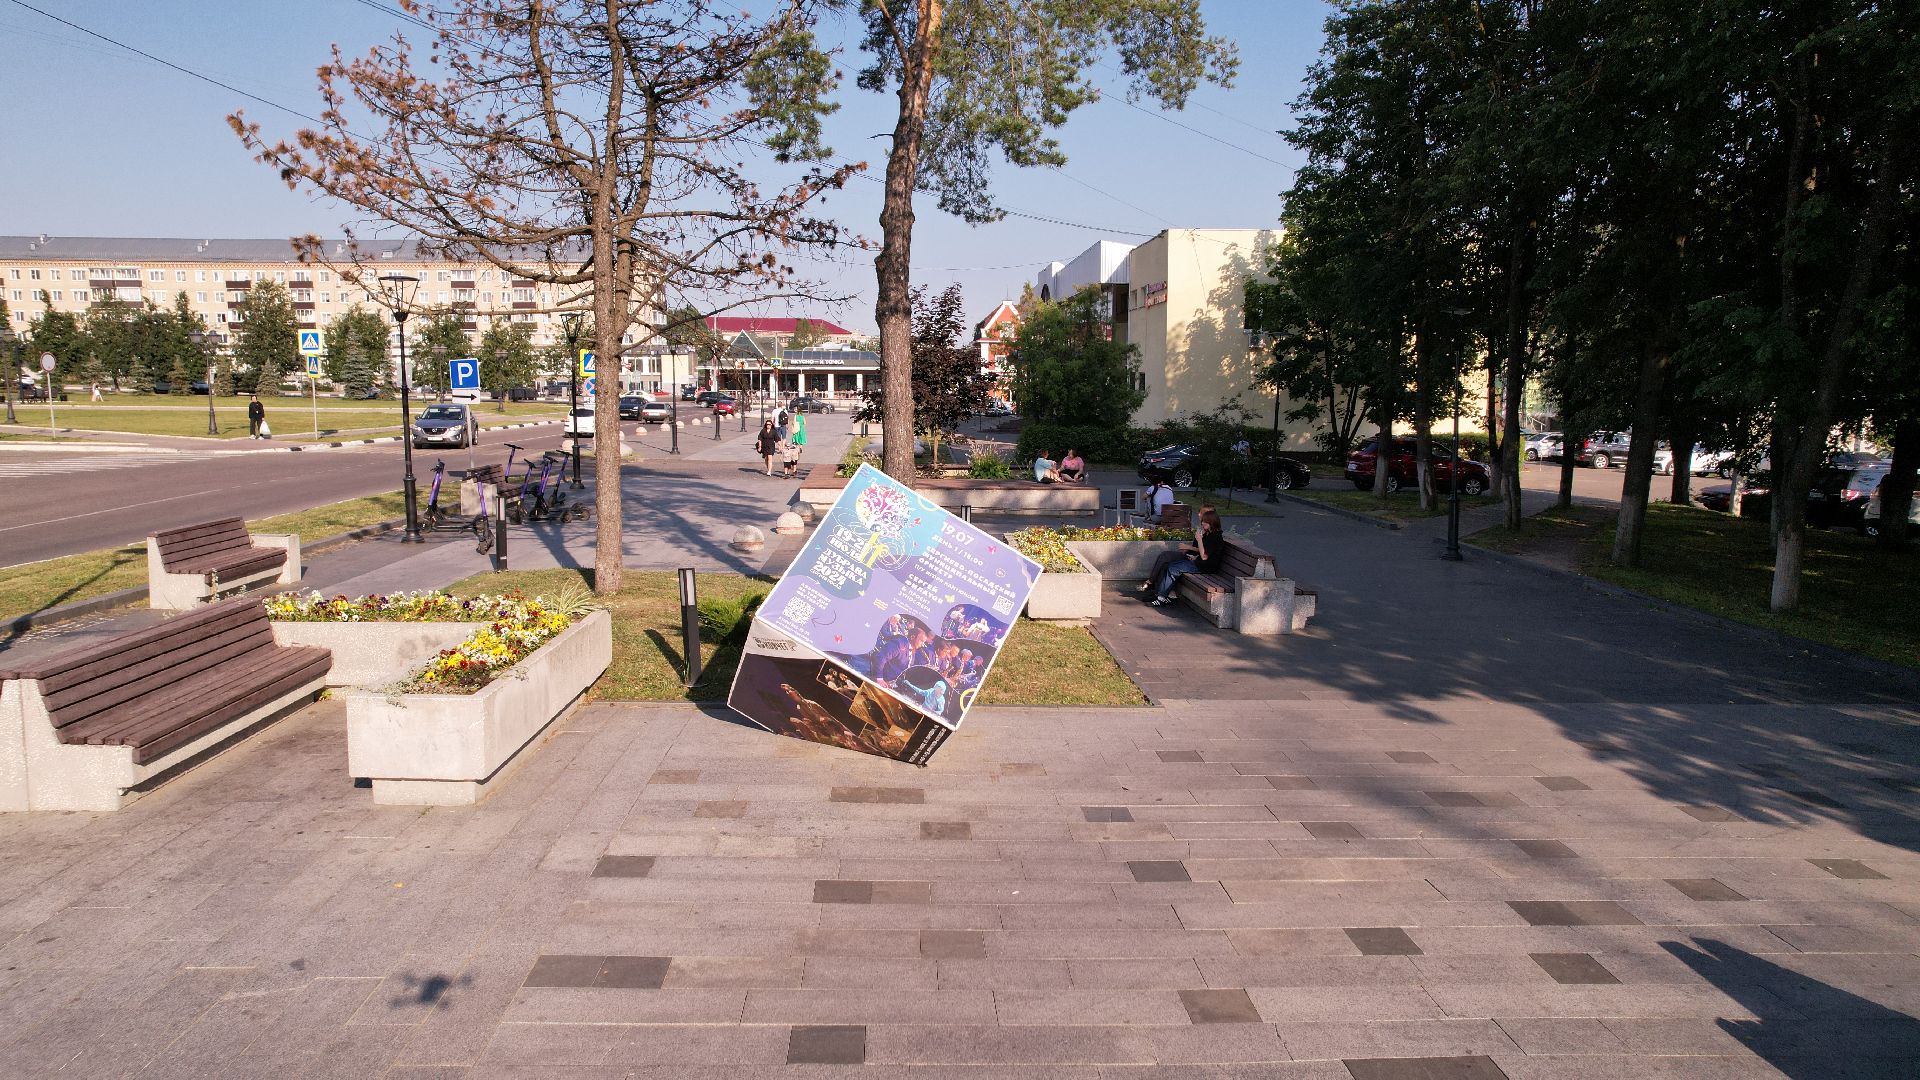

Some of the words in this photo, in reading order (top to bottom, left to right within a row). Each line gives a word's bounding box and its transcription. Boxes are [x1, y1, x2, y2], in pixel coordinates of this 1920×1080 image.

[458, 362, 473, 386] P
[940, 522, 973, 546] 19.07
[932, 534, 952, 548] ДЕНЬ
[964, 552, 982, 565] 18:00
[812, 561, 846, 584] 2024
[818, 554, 863, 584] МУЗЫКА
[823, 548, 868, 577] ДУБРАВА
[918, 558, 952, 578] ОРКЕСТР
[922, 552, 995, 595] МУНИЦИПАЛЬНЫЙ
[926, 546, 1015, 598] СЕРГИЕВО-ПОСАДСКИЙ
[905, 580, 942, 603] ФИЛАТОВ
[908, 573, 938, 592] СЕРГЕЙ
